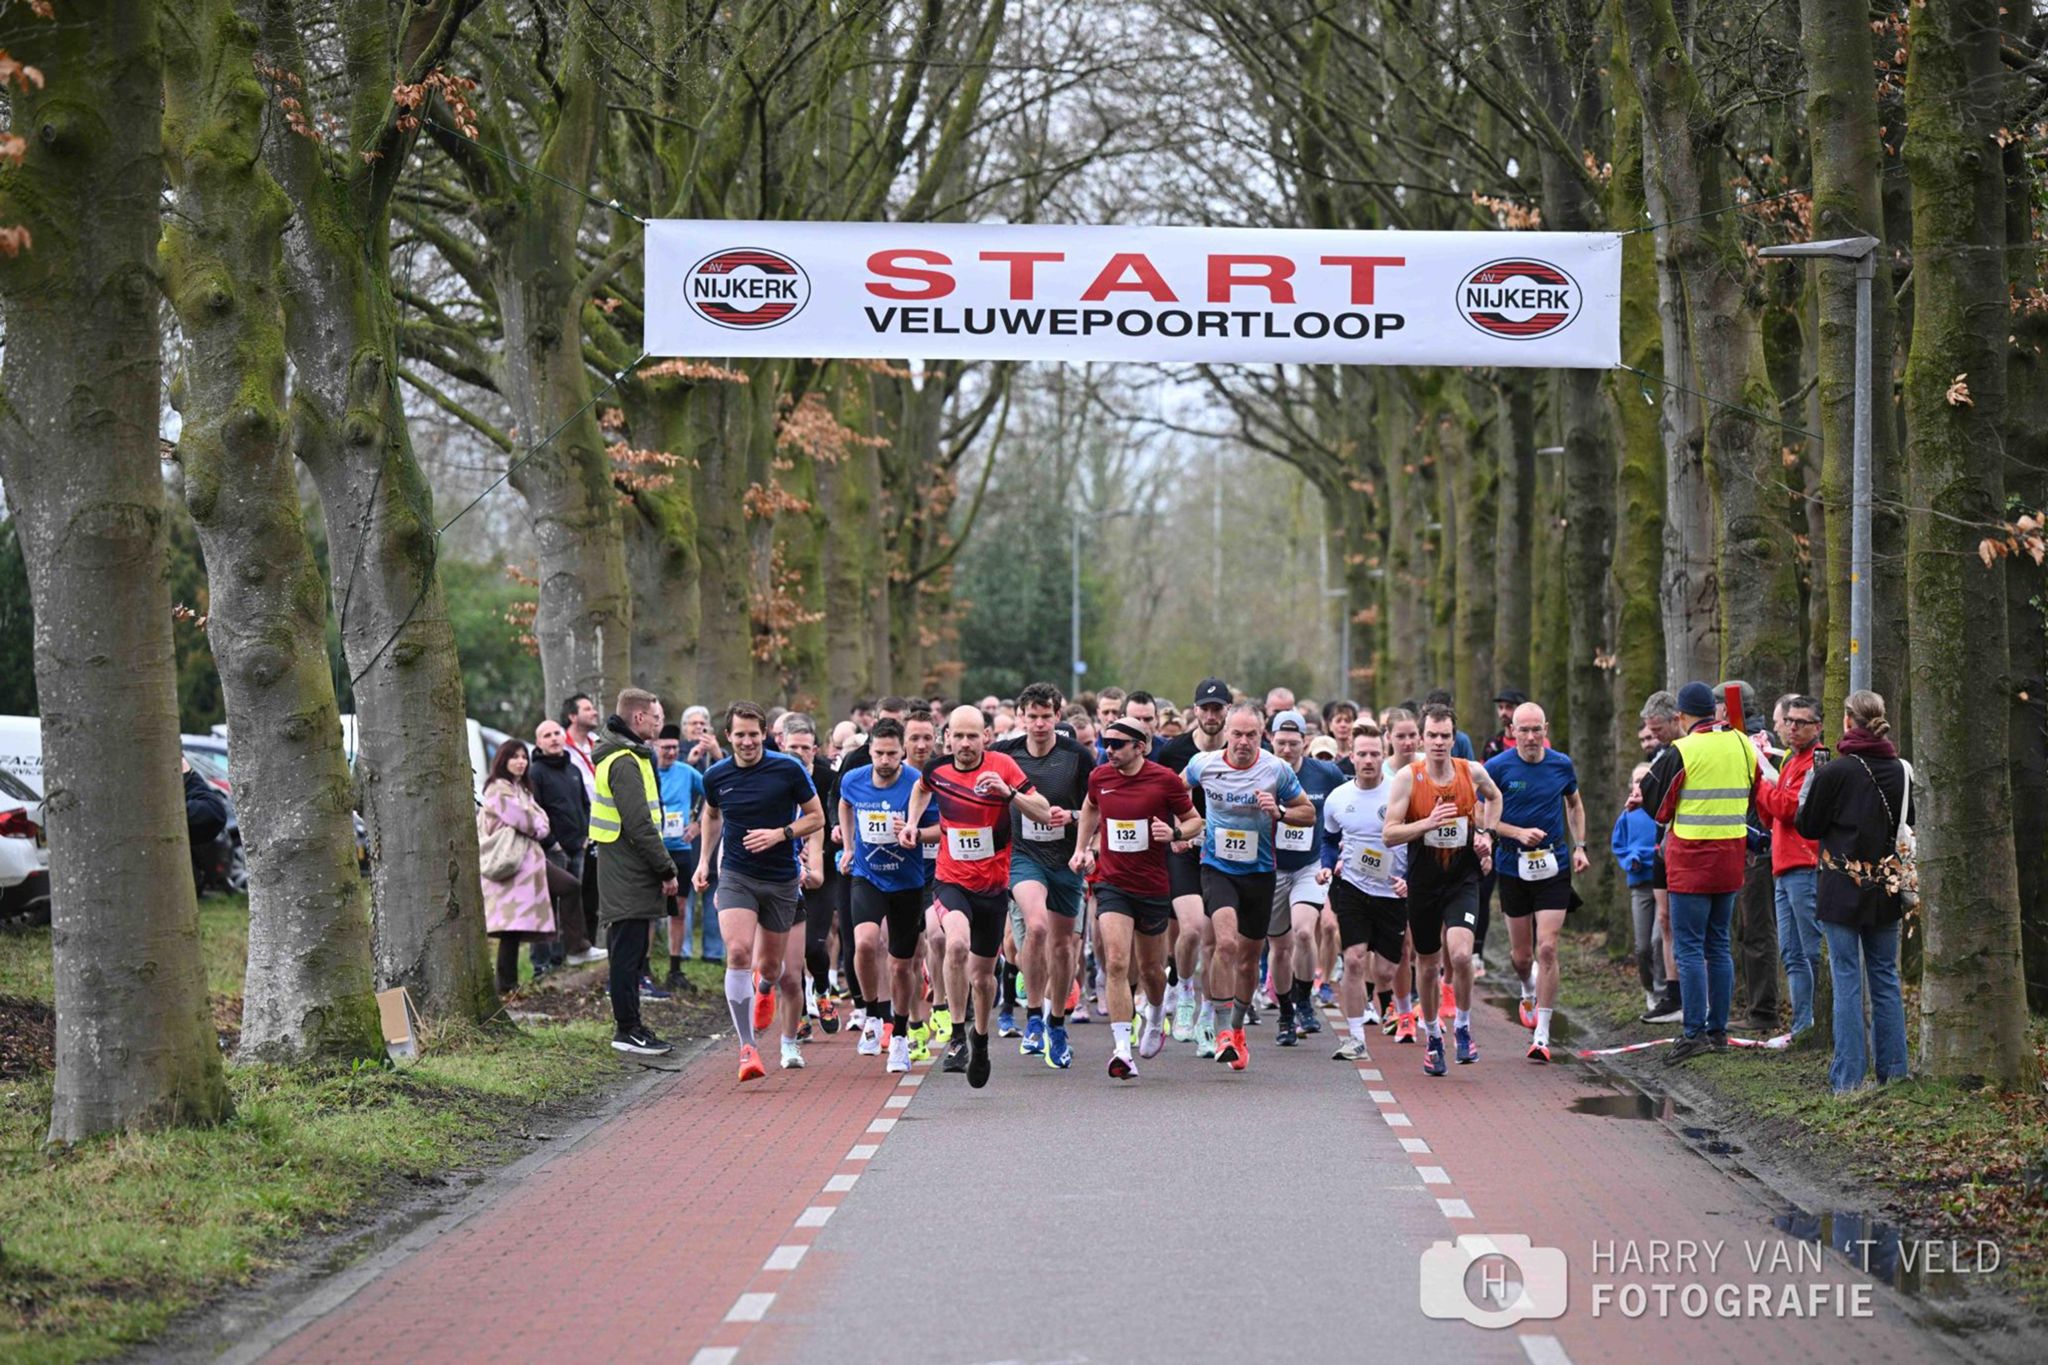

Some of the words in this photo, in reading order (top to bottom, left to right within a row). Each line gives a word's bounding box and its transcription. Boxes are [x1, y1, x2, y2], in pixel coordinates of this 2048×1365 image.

[708, 262, 723, 273] AV
[864, 248, 1406, 305] START
[1480, 272, 1496, 283] AV
[694, 277, 798, 299] NIJKERK
[1466, 287, 1569, 309] NIJKERK
[864, 306, 1406, 340] VELUWEPOORTLOOP
[1206, 787, 1224, 802] Bos
[1226, 792, 1259, 804] Bedd
[868, 822, 887, 832] 211
[1438, 827, 1457, 837] 136
[1116, 829, 1136, 840] 132
[1285, 829, 1304, 840] 092
[959, 838, 981, 849] 115
[1225, 838, 1246, 850] 212
[1361, 854, 1381, 868] 093
[1528, 859, 1547, 870] 213
